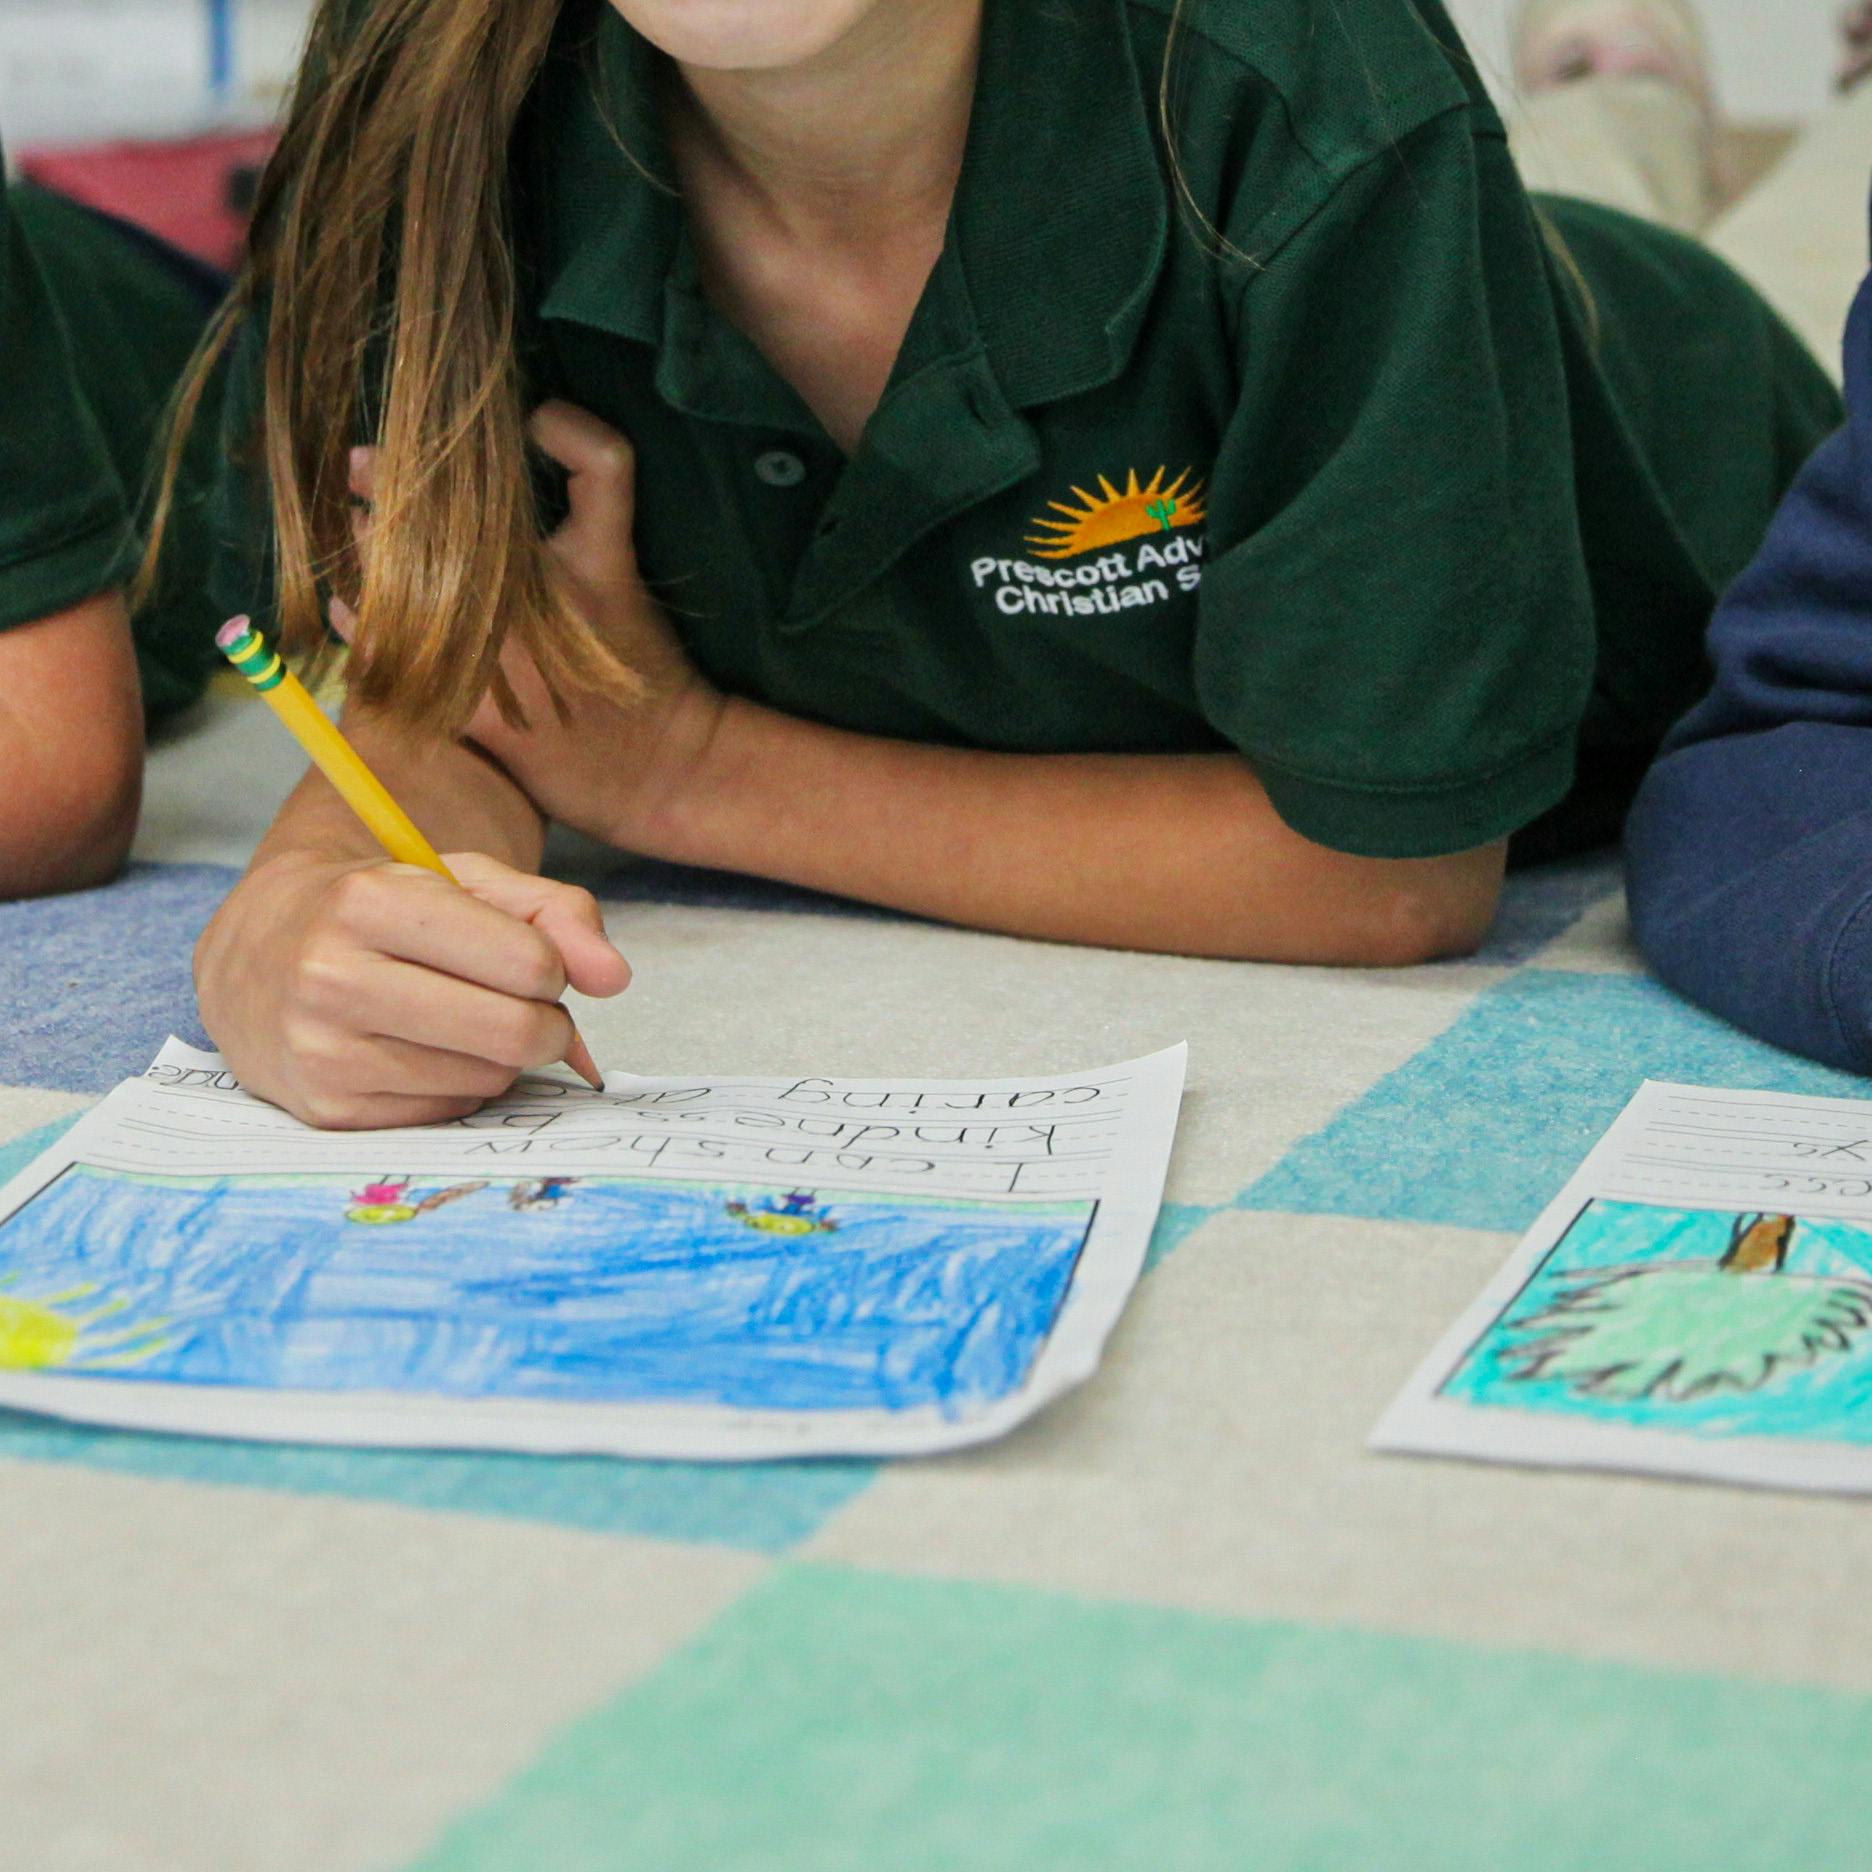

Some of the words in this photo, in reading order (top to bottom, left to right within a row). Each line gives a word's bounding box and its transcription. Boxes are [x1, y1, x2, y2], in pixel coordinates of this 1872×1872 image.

[969, 552, 1134, 589] Prescott
[994, 578, 1170, 618] Christian
[778, 1078, 1101, 1115] caring
[636, 1111, 1056, 1157] kindness
[992, 1161, 1025, 1194] I
